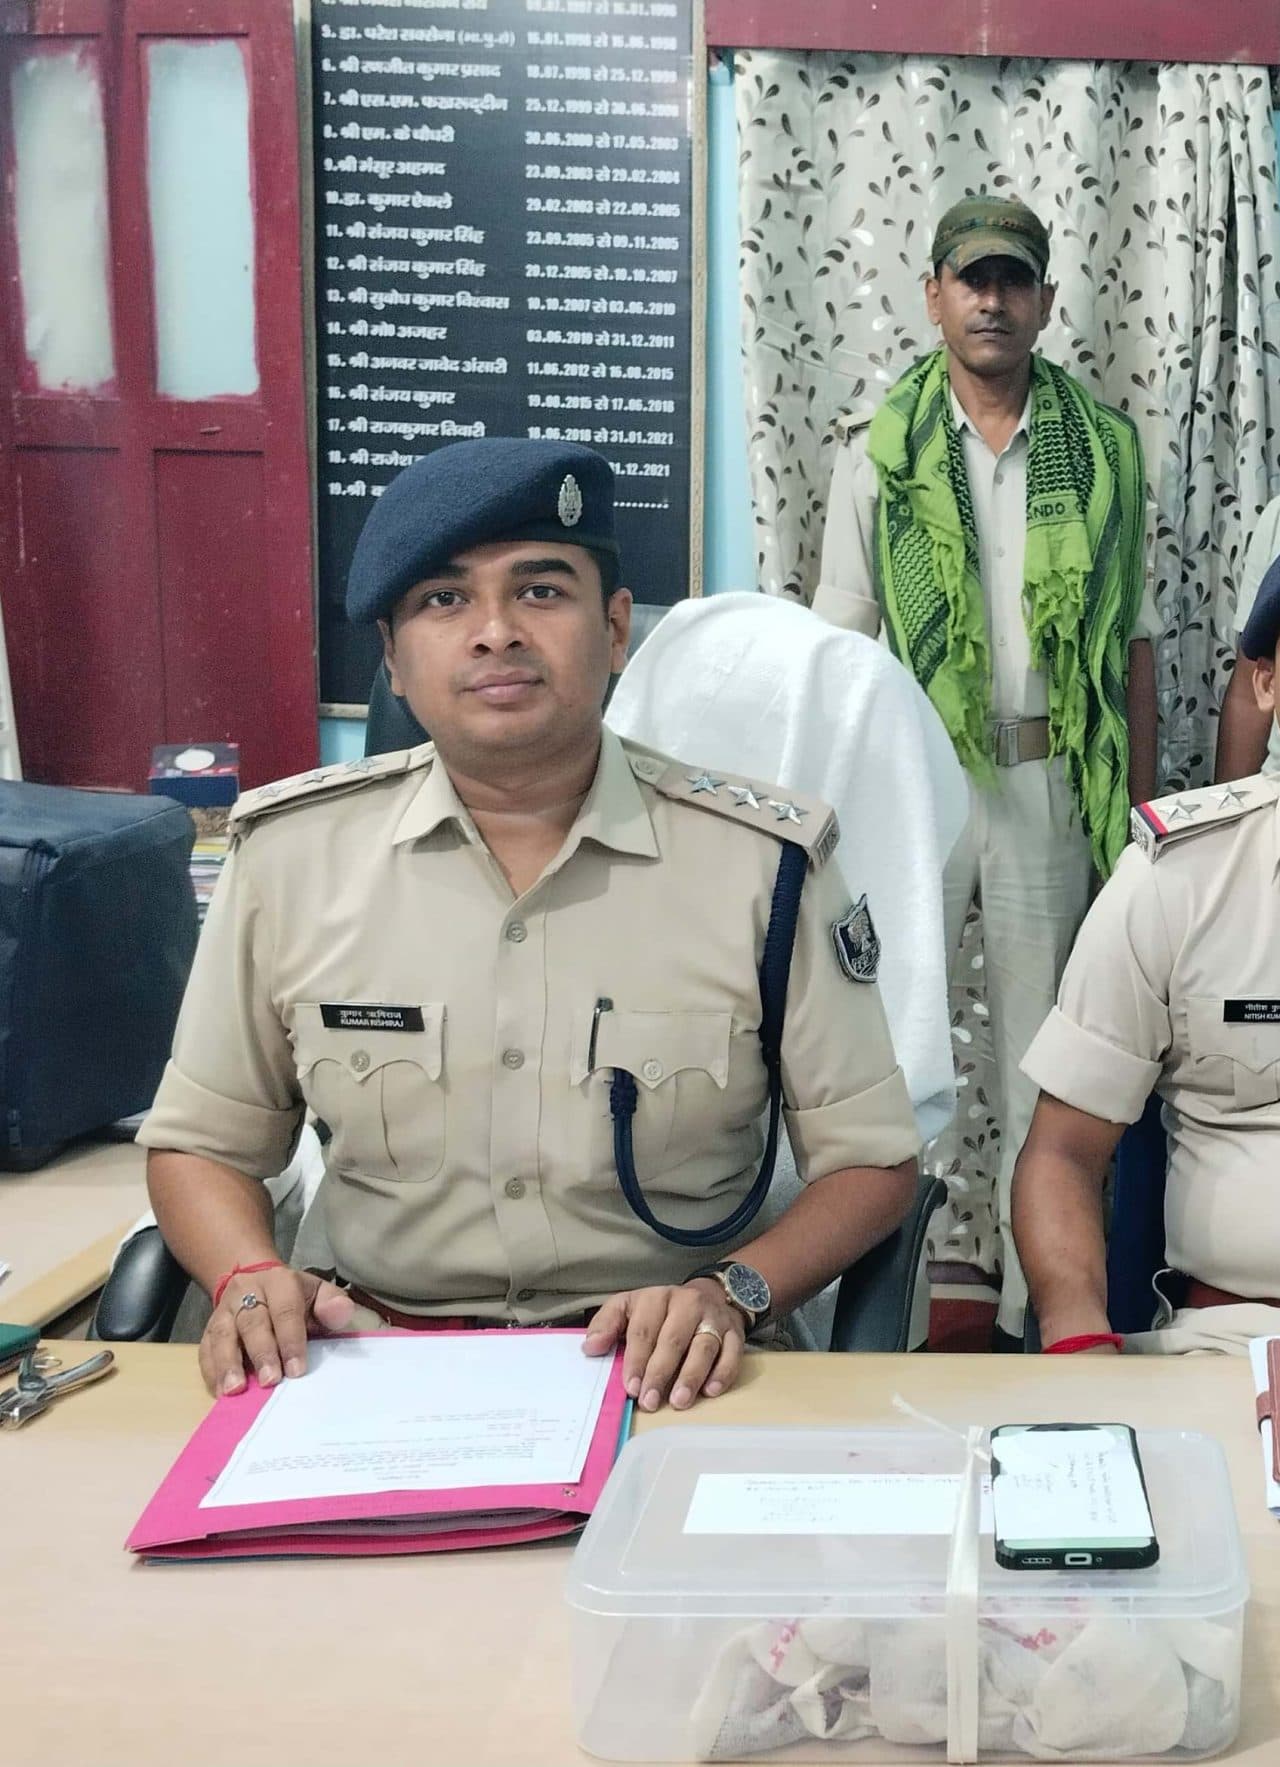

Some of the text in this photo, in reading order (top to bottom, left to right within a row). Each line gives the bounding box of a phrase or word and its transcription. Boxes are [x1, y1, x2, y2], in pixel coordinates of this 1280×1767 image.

[594, 32, 607, 47] से
[339, 56, 359, 73] श्री
[416, 63, 459, 81] कुमार
[593, 65, 607, 81] से
[339, 89, 359, 106] श्री
[594, 99, 609, 114] से
[340, 122, 360, 139] श्री
[595, 132, 610, 148] से
[595, 166, 610, 181] से
[367, 193, 410, 212] कुमार
[595, 199, 610, 215] से
[326, 224, 343, 237] 11.
[346, 221, 365, 239] श्री
[368, 223, 409, 239] संजय
[410, 228, 453, 246] कुमार
[454, 225, 484, 243] सिंह
[596, 232, 611, 248] से
[326, 257, 344, 270] 12.
[347, 254, 367, 271] श्री
[369, 256, 410, 272] संजय
[412, 261, 454, 279] कुमार
[456, 258, 486, 276] सिंह
[326, 289, 345, 302] 13.
[348, 287, 367, 303] श्री
[369, 289, 410, 310] सुबोध
[412, 293, 454, 311] कुमार
[592, 298, 607, 313] से
[327, 321, 346, 334] 14.
[349, 319, 368, 336] श्री
[595, 331, 609, 346] से
[327, 354, 345, 367] 15.
[349, 351, 368, 368] श्री
[592, 363, 606, 378] से
[327, 386, 345, 398] 16.
[349, 384, 368, 400] श्री
[370, 386, 411, 402] संजय
[413, 391, 456, 409] कुमार
[594, 395, 609, 410] से
[328, 418, 345, 431] 17.
[348, 416, 367, 433] श्री
[369, 421, 439, 440] राजकुमार
[440, 420, 485, 437] तिवारी
[593, 427, 607, 442] से
[610, 430, 673, 445] 31.01.2021
[328, 450, 346, 463] 18.
[349, 449, 368, 465] श्री
[370, 451, 412, 466] राजेश
[1034, 502, 1065, 519] NDO
[341, 1018, 369, 1026] KUMAR
